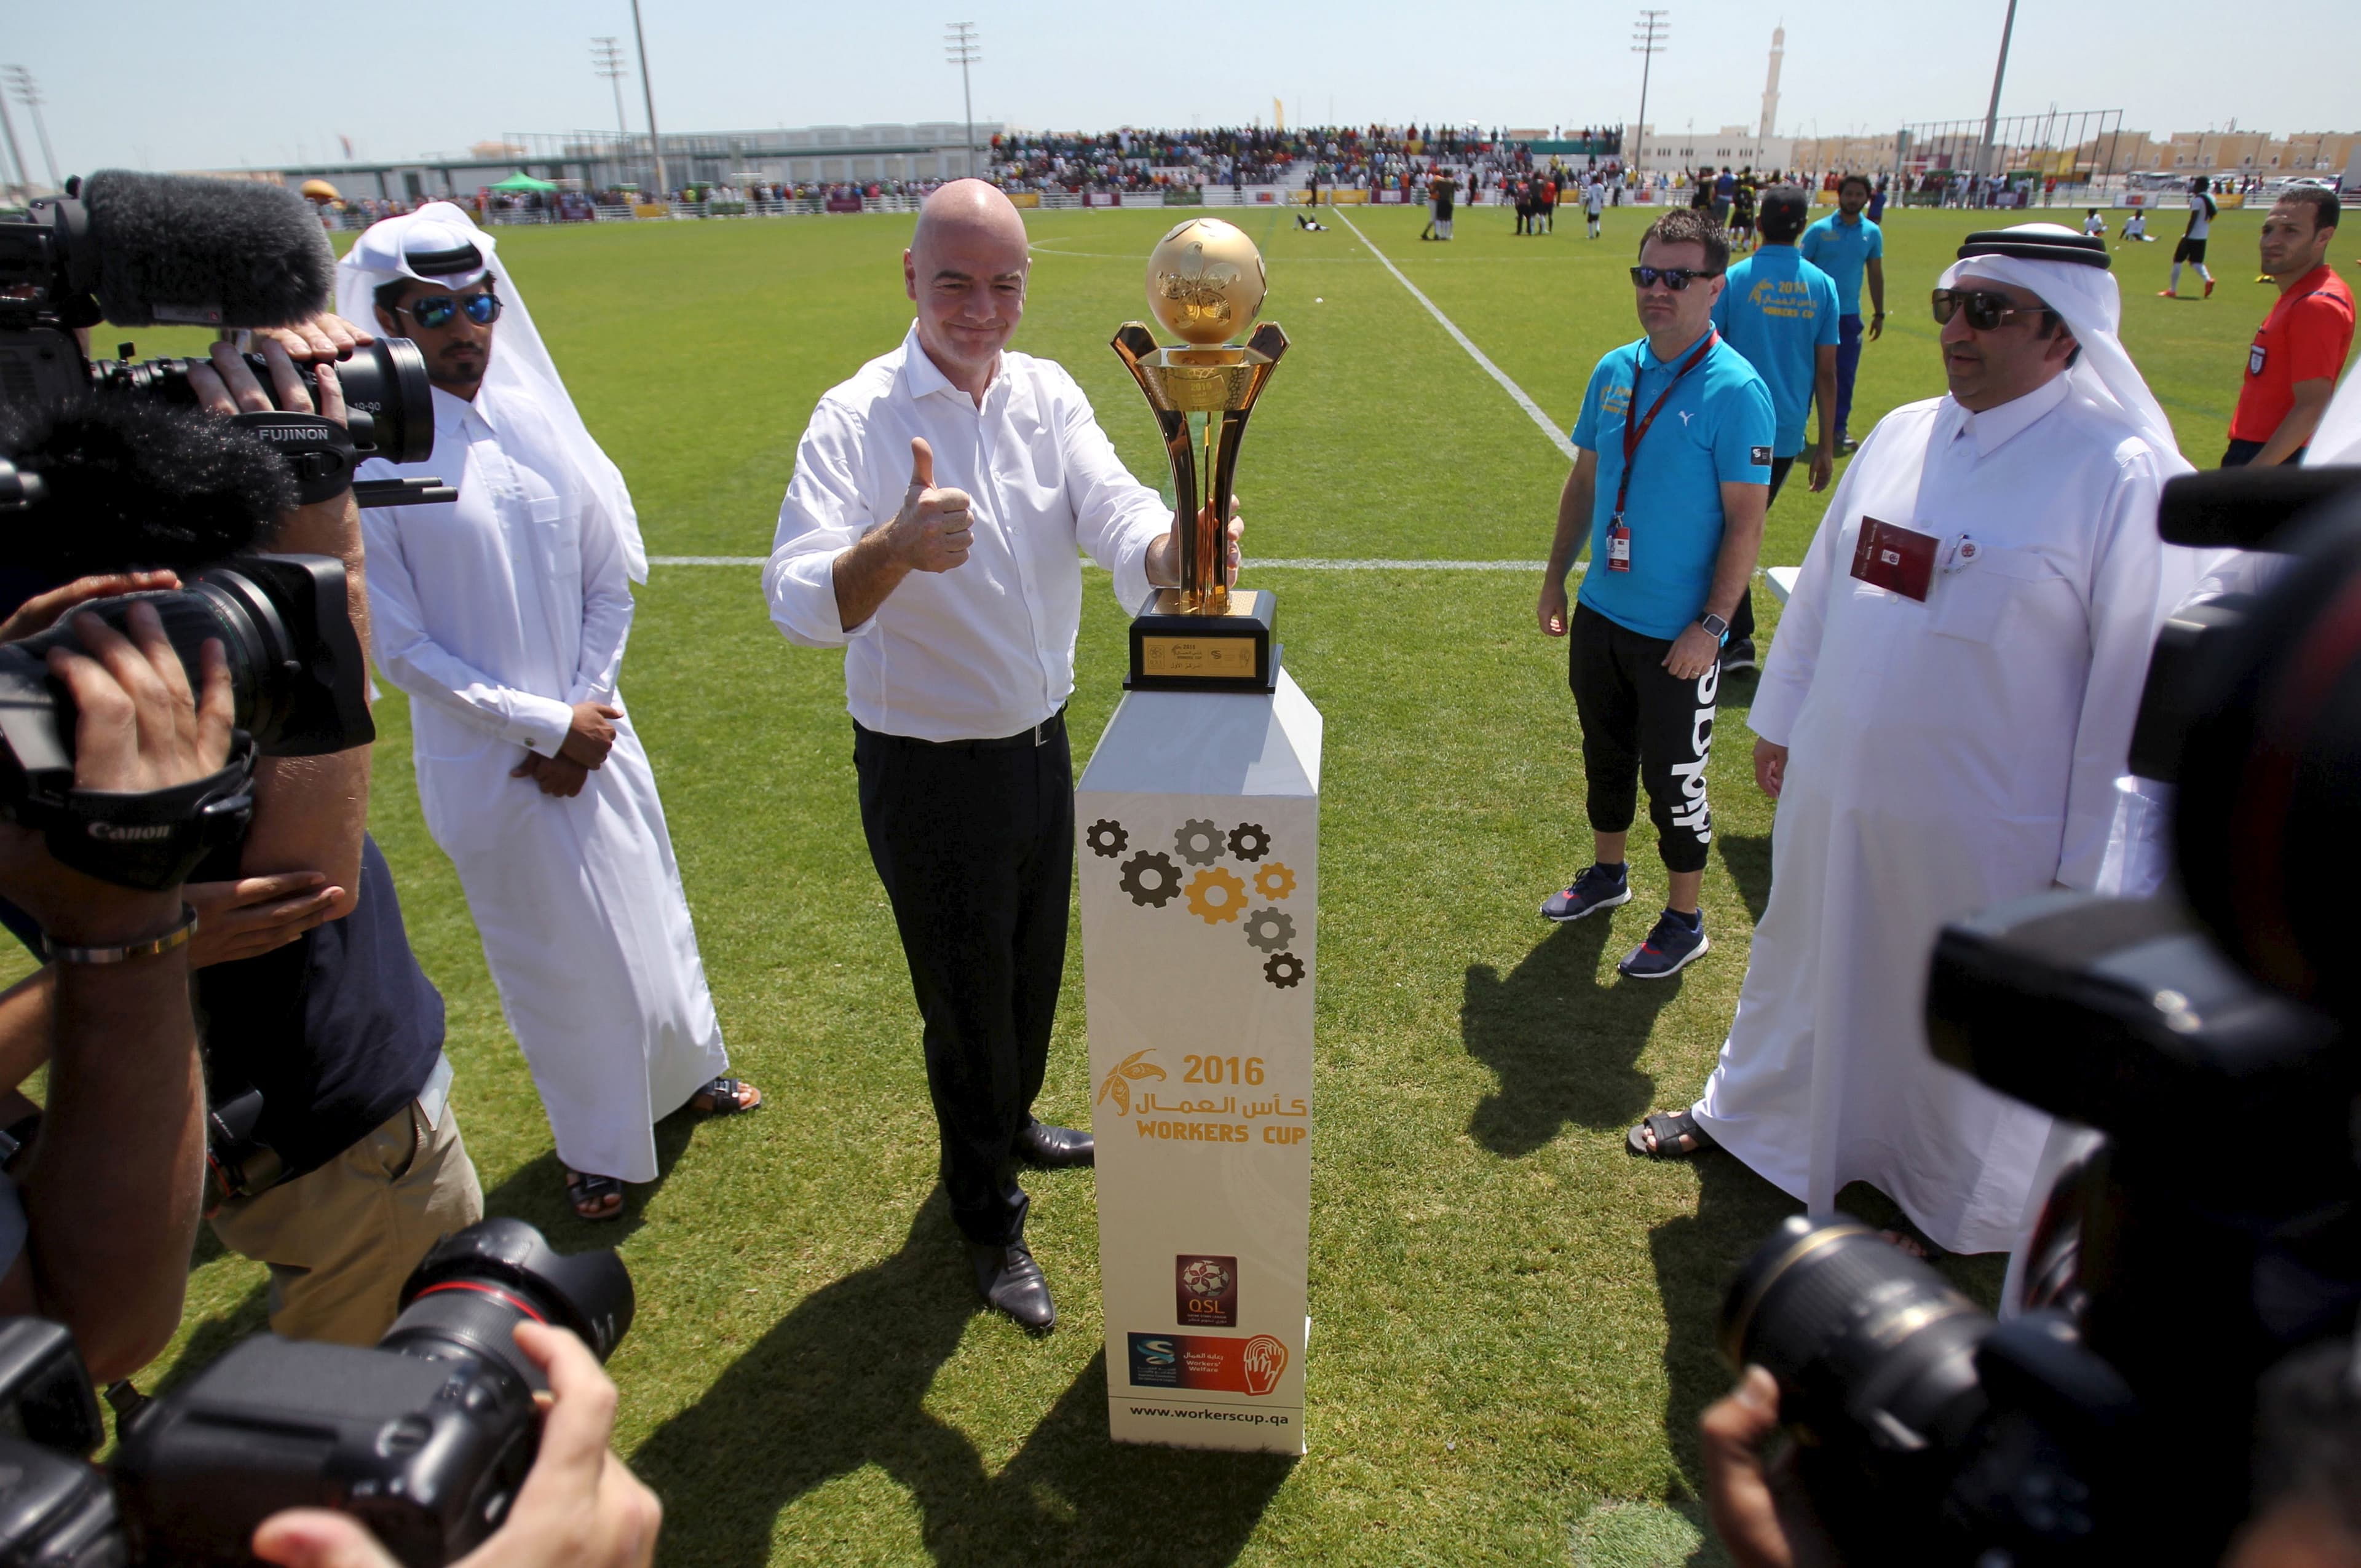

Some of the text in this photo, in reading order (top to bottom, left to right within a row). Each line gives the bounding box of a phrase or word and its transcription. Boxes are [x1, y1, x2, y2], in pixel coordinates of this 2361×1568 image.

[259, 429, 328, 441] FUJINON
[87, 822, 170, 840] Canon
[1183, 1054, 1265, 1085] 2016
[1136, 1093, 1307, 1119] كأس العمال
[1136, 1121, 1306, 1144] WORKERS CUP
[1189, 1299, 1225, 1314] QSL
[1130, 1406, 1288, 1425] www.workerscup.qa
